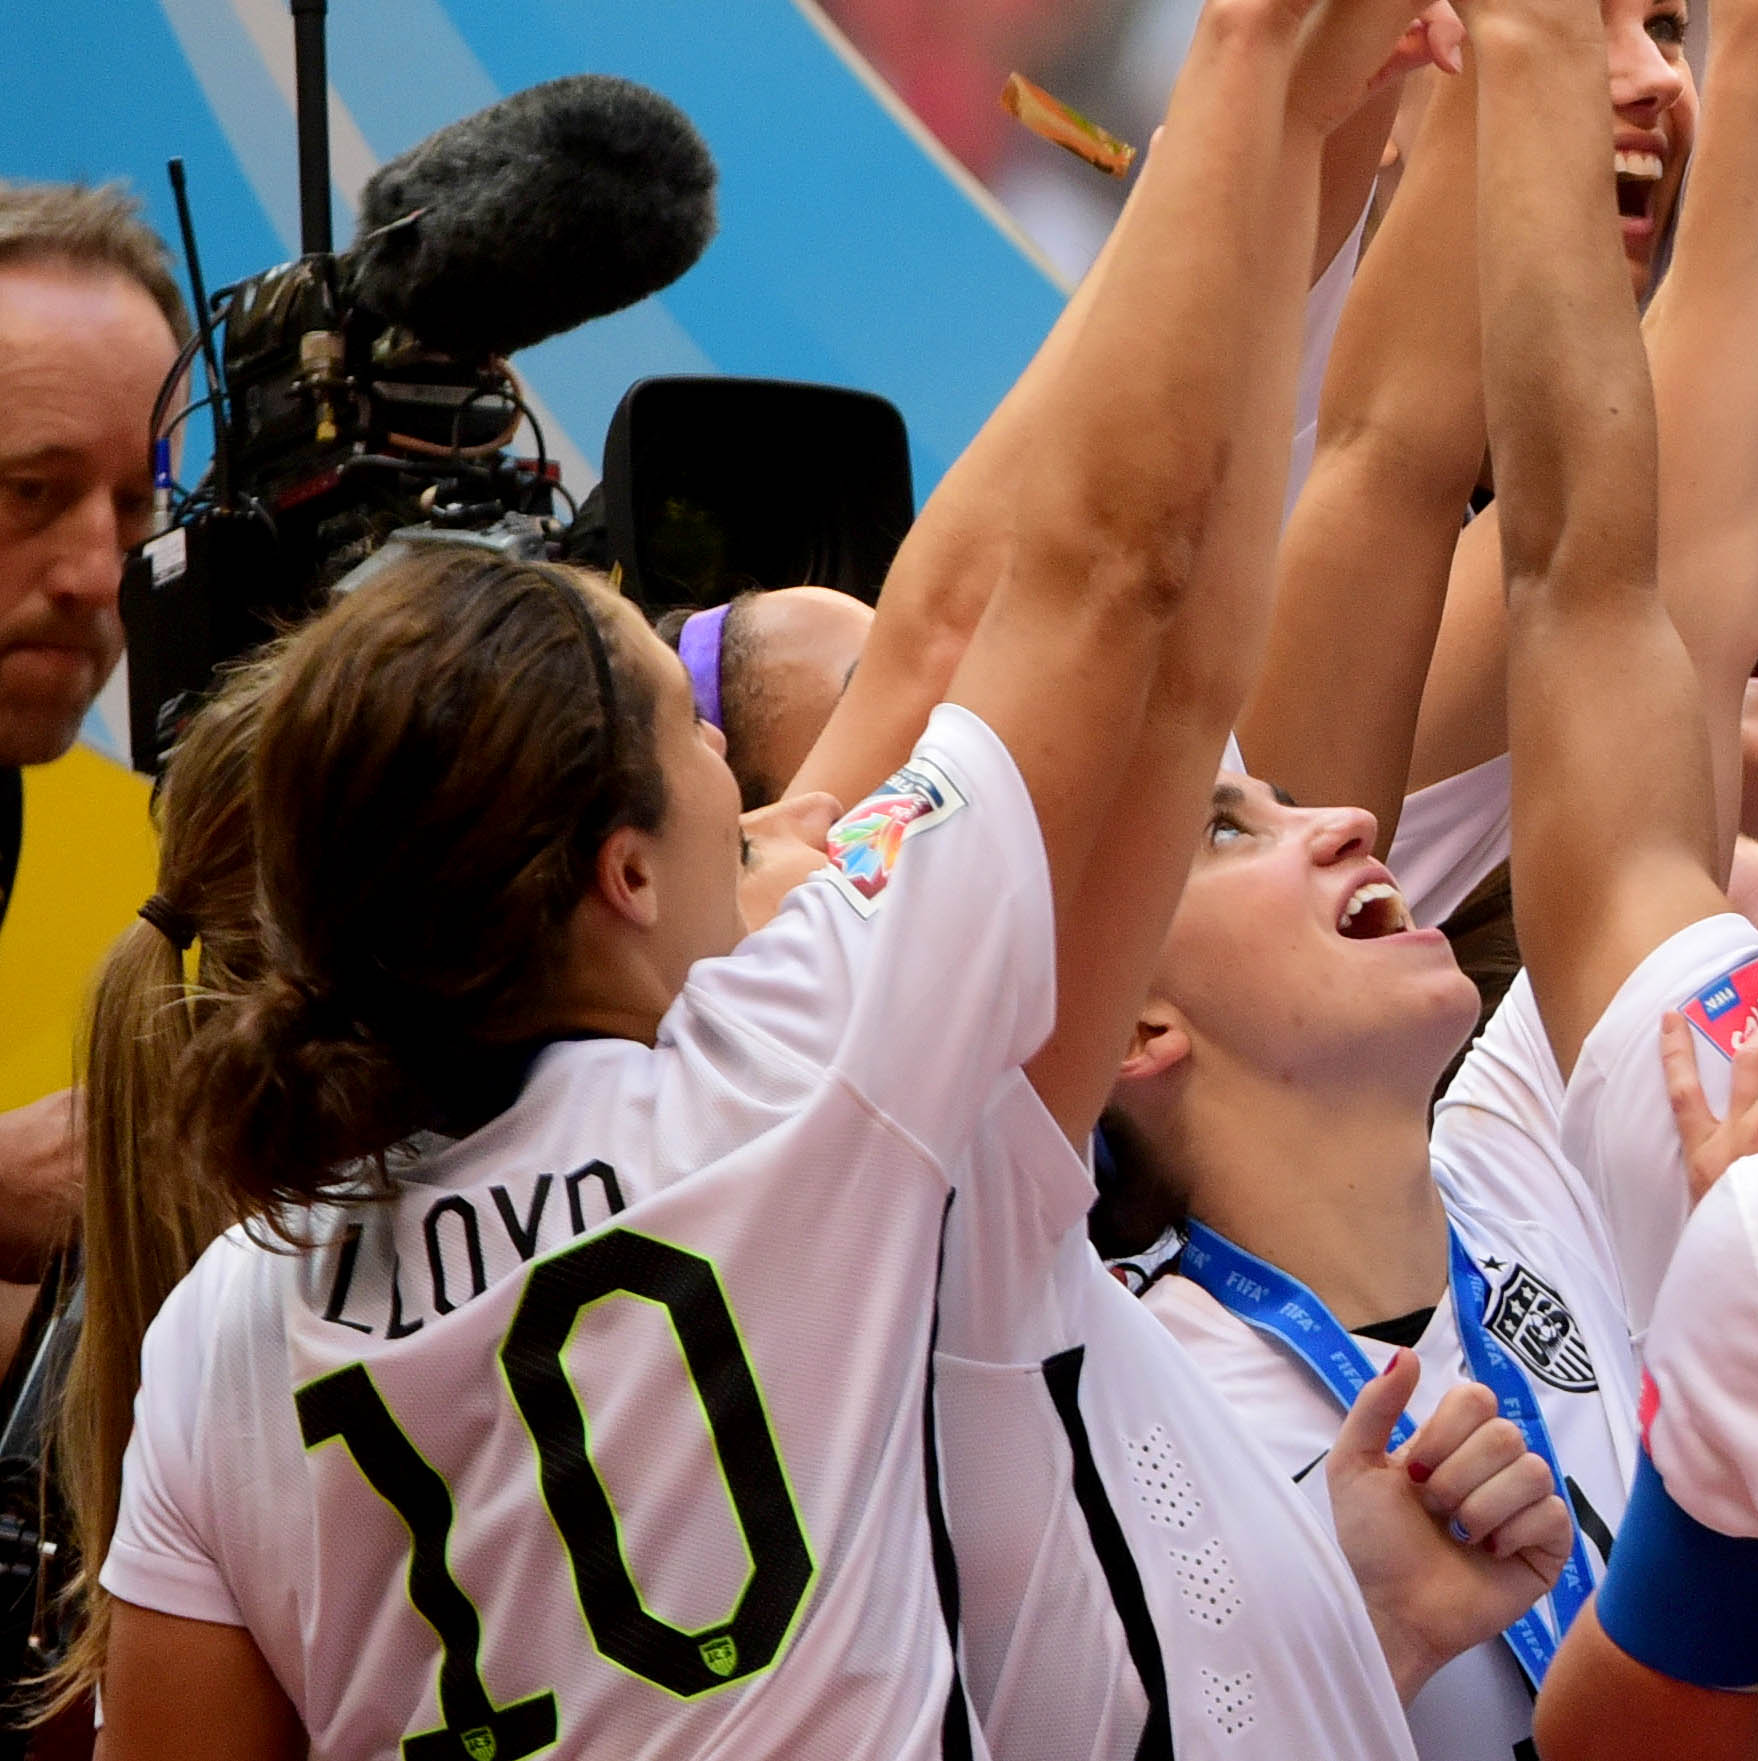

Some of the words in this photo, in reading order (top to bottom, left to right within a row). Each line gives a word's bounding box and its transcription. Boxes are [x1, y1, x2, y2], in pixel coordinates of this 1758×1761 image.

[1703, 987, 1737, 1012] FIFA
[1225, 1270, 1265, 1303] FIFA
[1279, 1301, 1318, 1334] FIFA
[294, 1226, 817, 1761] 10
[1514, 1617, 1548, 1664] FIFA
